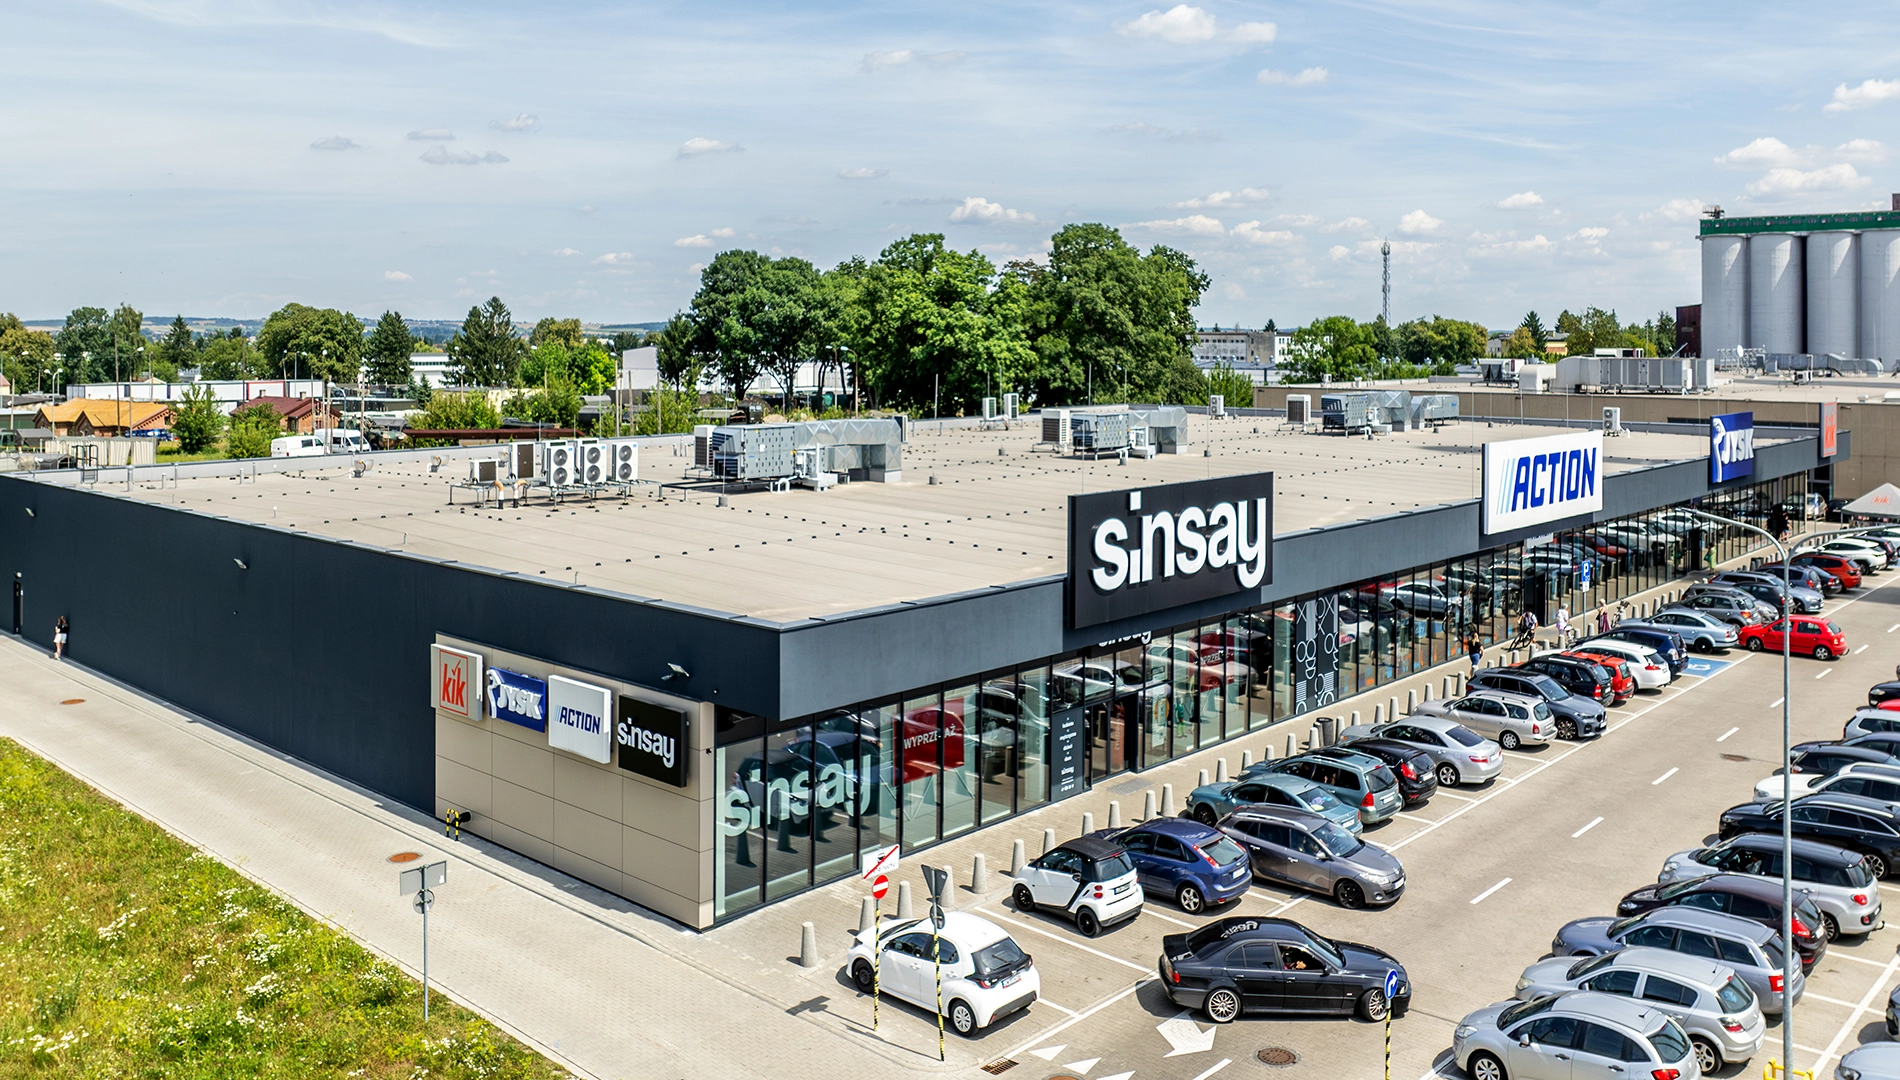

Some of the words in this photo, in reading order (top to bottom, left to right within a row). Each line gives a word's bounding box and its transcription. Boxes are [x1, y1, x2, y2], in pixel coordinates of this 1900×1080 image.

[1722, 428, 1754, 464] JYSK
[1513, 448, 1596, 512] ACTION
[1092, 490, 1267, 591] sinsay
[1583, 562, 1590, 577] P
[441, 659, 467, 709] kik
[497, 684, 542, 720] JYSK
[559, 706, 600, 735] ACTION
[903, 723, 956, 750] WYPRZEAŻ
[617, 718, 675, 768] sinsay
[724, 754, 871, 837] sinsay
